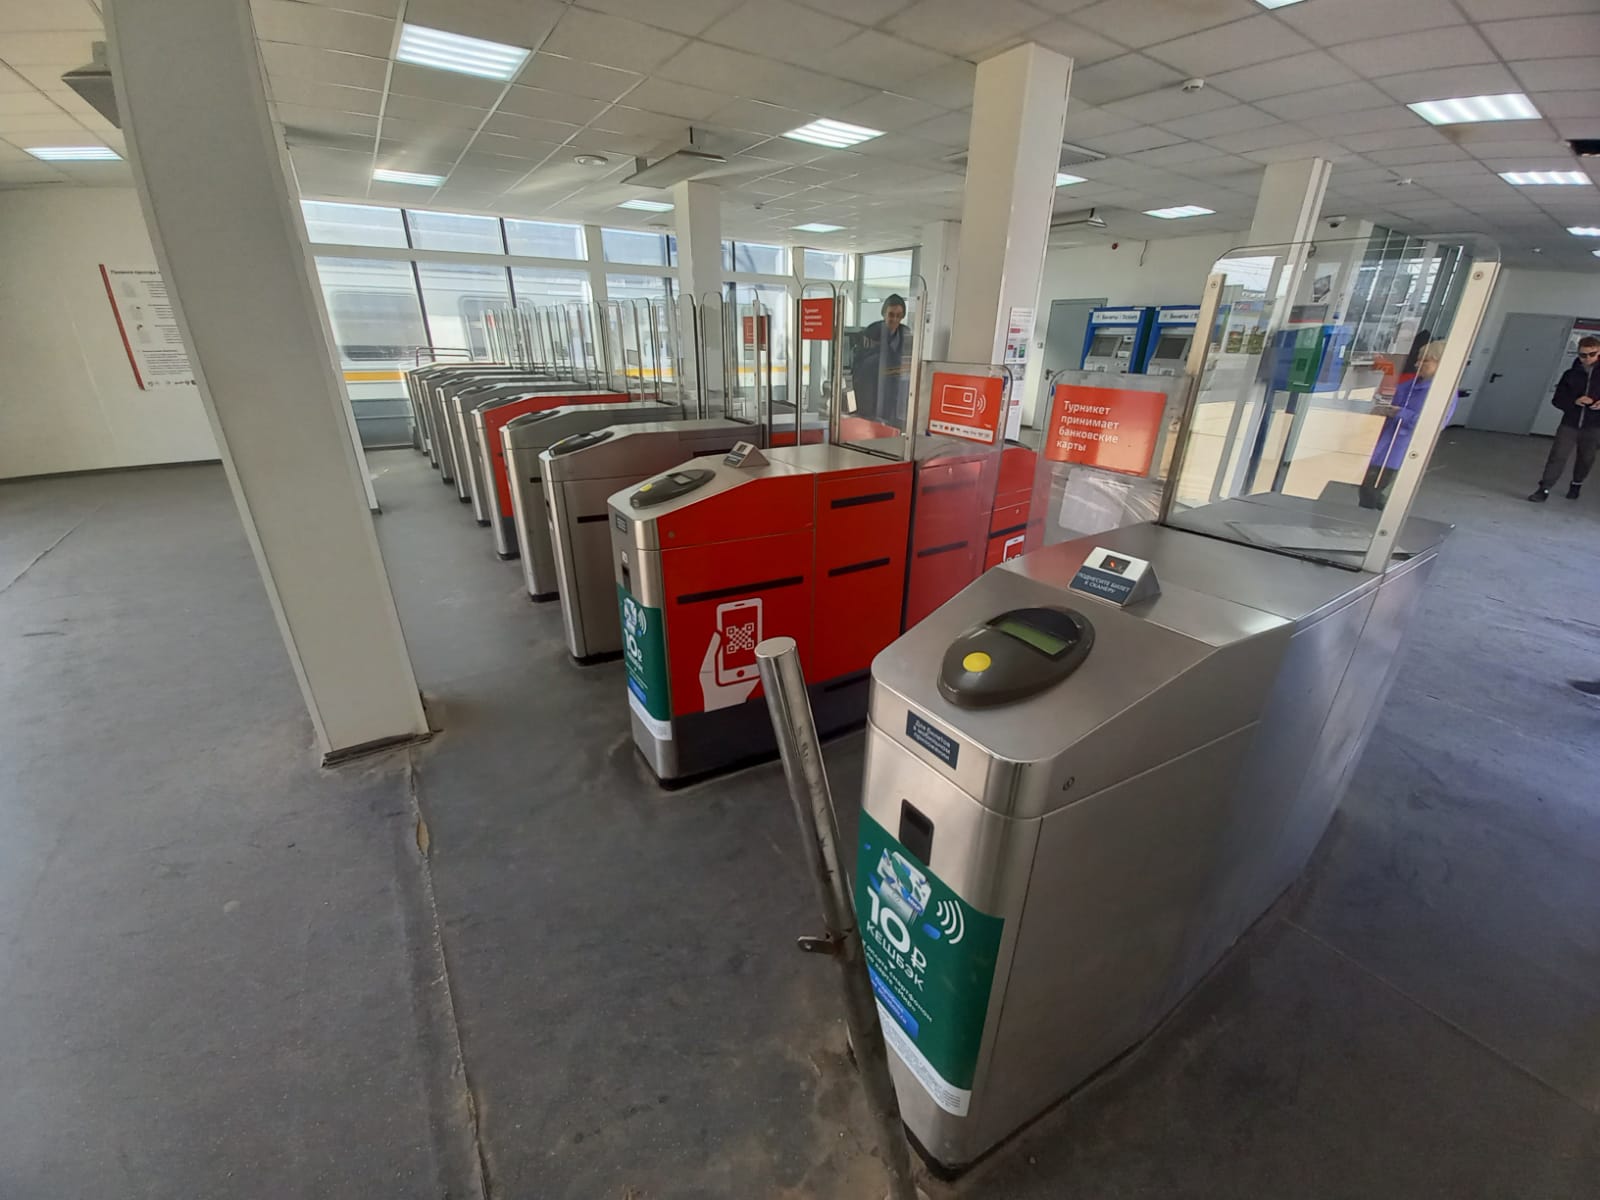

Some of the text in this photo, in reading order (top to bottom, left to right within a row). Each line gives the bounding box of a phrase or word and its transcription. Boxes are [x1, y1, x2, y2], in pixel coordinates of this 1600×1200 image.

[1063, 400, 1112, 415] Турникет
[1060, 415, 1120, 430] принимает
[1058, 426, 1119, 443] банковские
[1056, 439, 1087, 451] карты
[866, 921, 924, 992] КЕШБЭК
